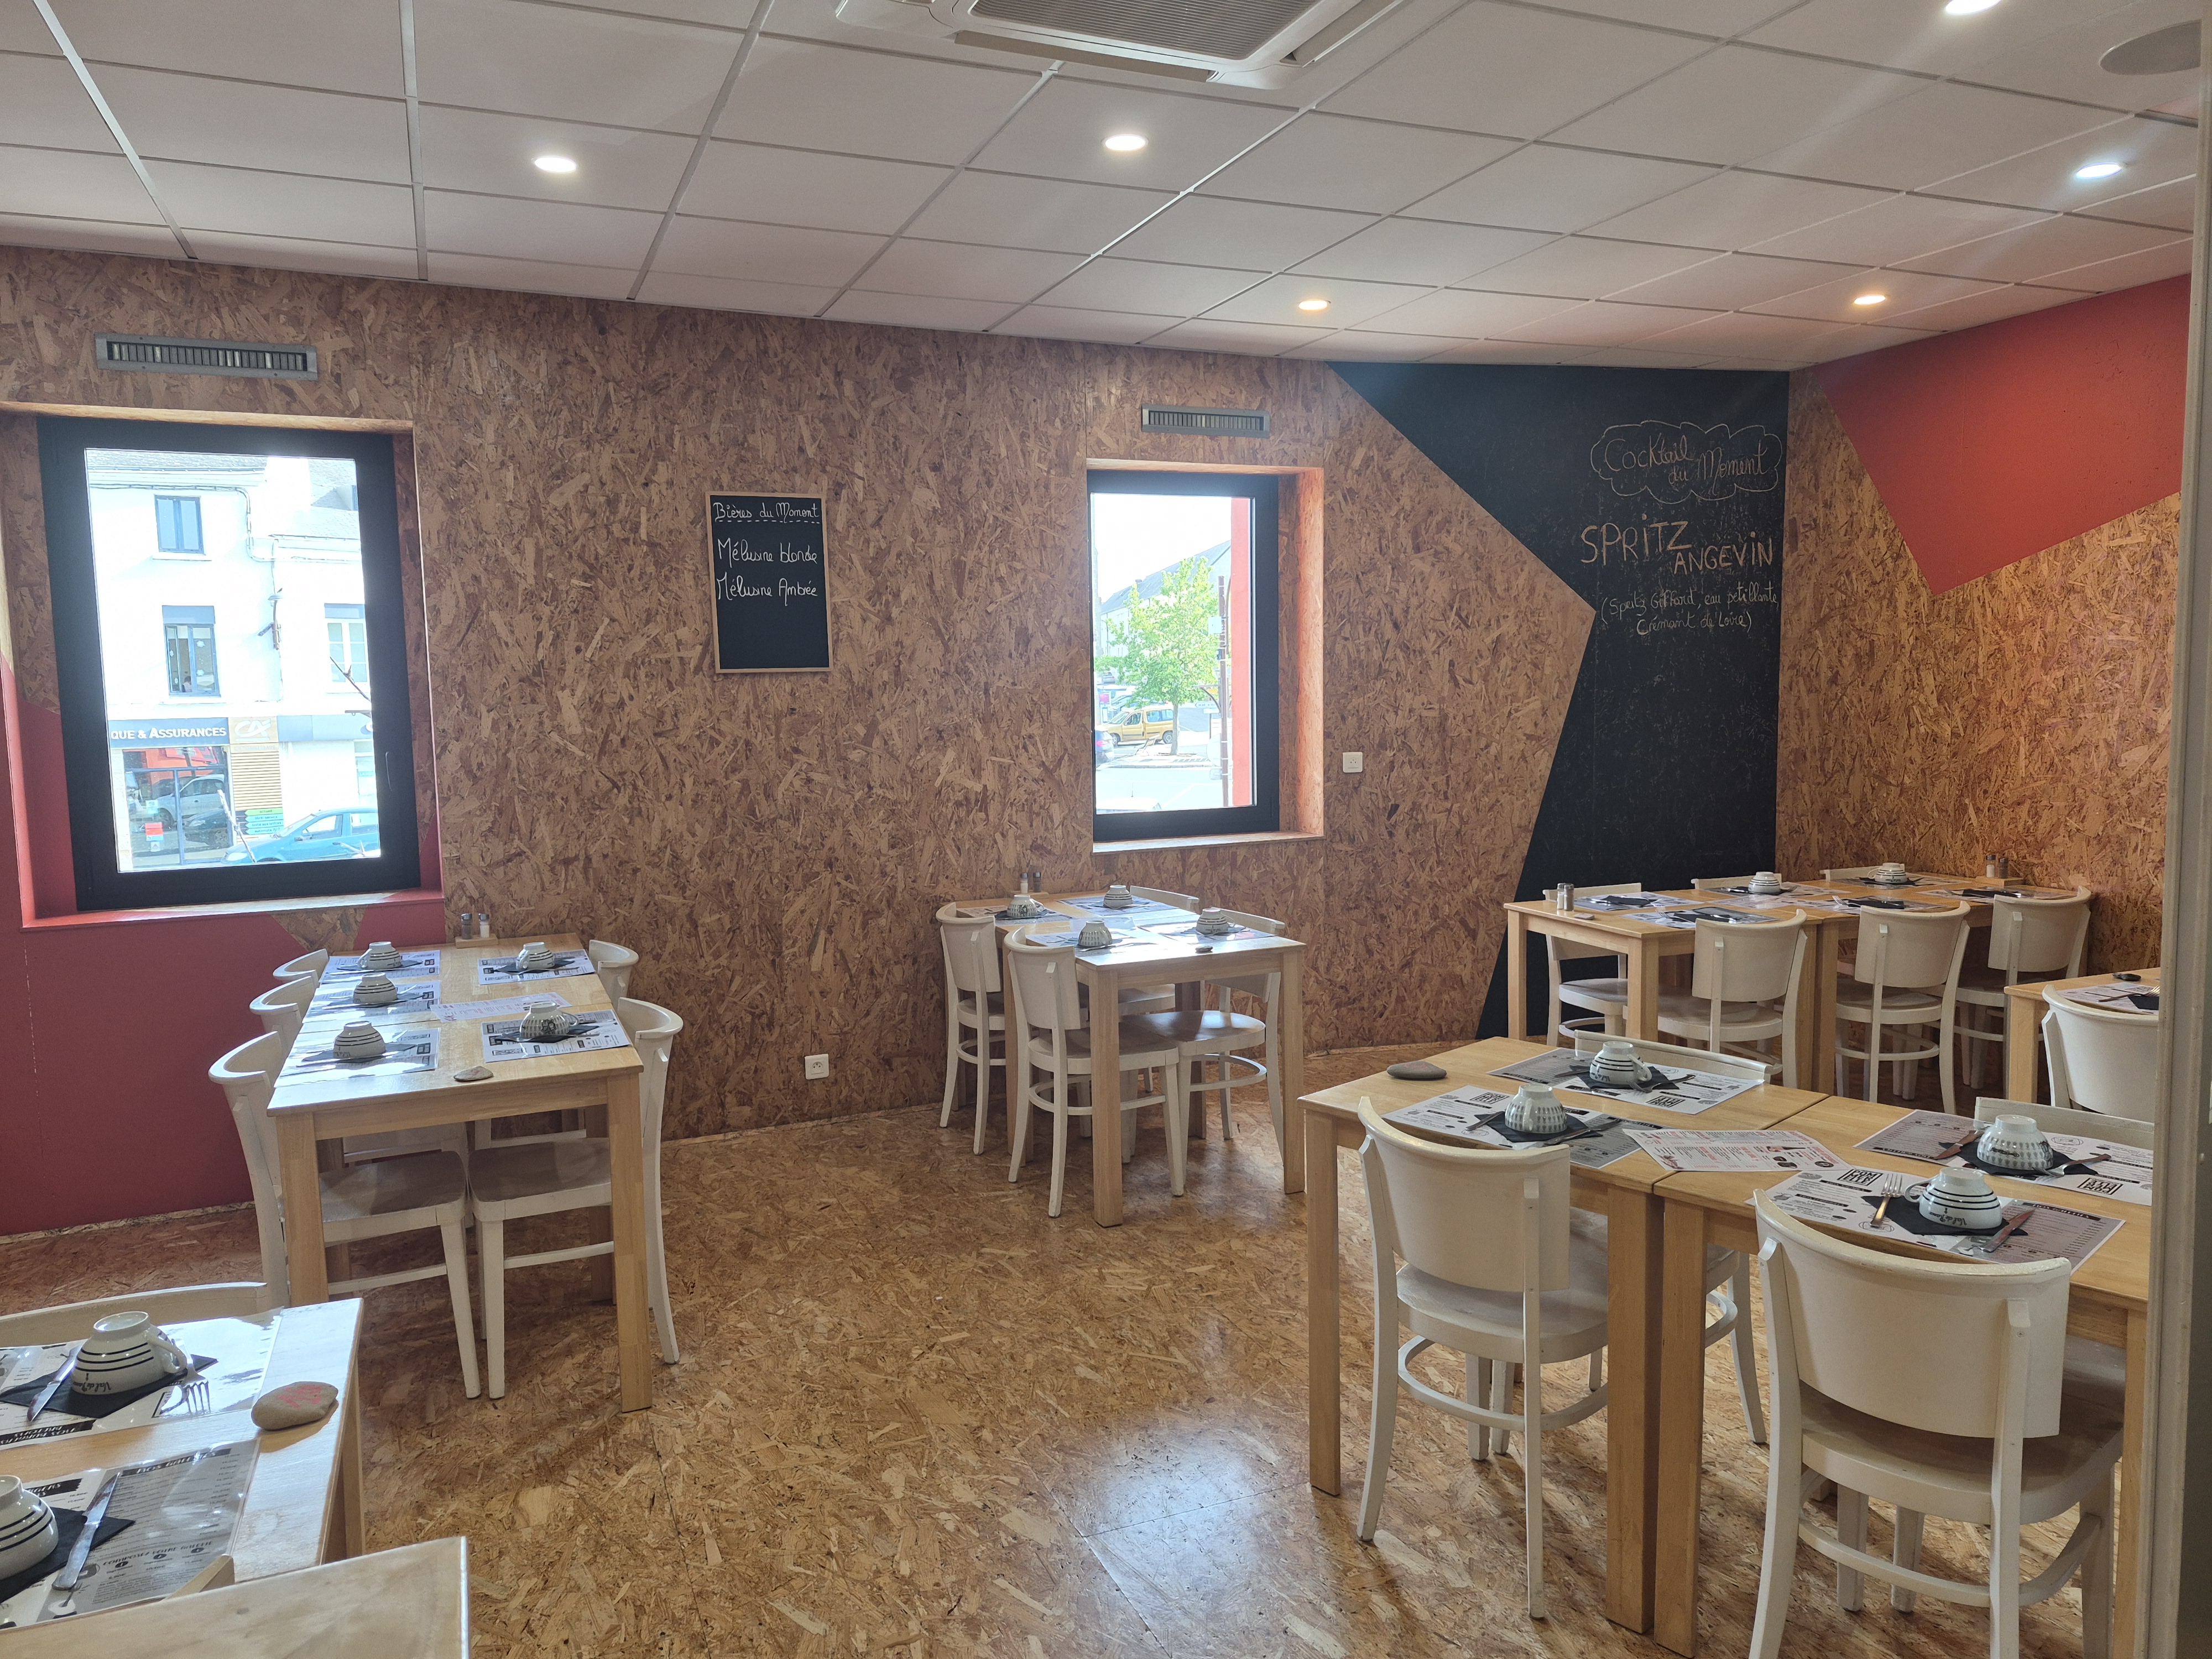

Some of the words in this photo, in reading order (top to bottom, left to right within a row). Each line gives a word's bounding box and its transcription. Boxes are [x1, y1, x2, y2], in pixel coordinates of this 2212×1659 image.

[1668, 465, 1689, 484] du
[1697, 440, 1769, 495] Moment
[713, 502, 752, 522] Bières
[760, 502, 774, 518] du
[776, 502, 820, 523] Moment
[717, 538, 774, 568] Mélusine
[780, 542, 818, 564] blonde
[717, 572, 773, 601] Mélusine
[779, 578, 818, 606] Ambrée
[1704, 594, 1721, 605] eau
[1700, 609, 1714, 628] de
[111, 730, 135, 739] QUE
[138, 729, 147, 739] &
[149, 727, 227, 738] ASSURANCES
[1952, 1217, 1967, 1226] Val
[95, 1381, 111, 1392] Val
